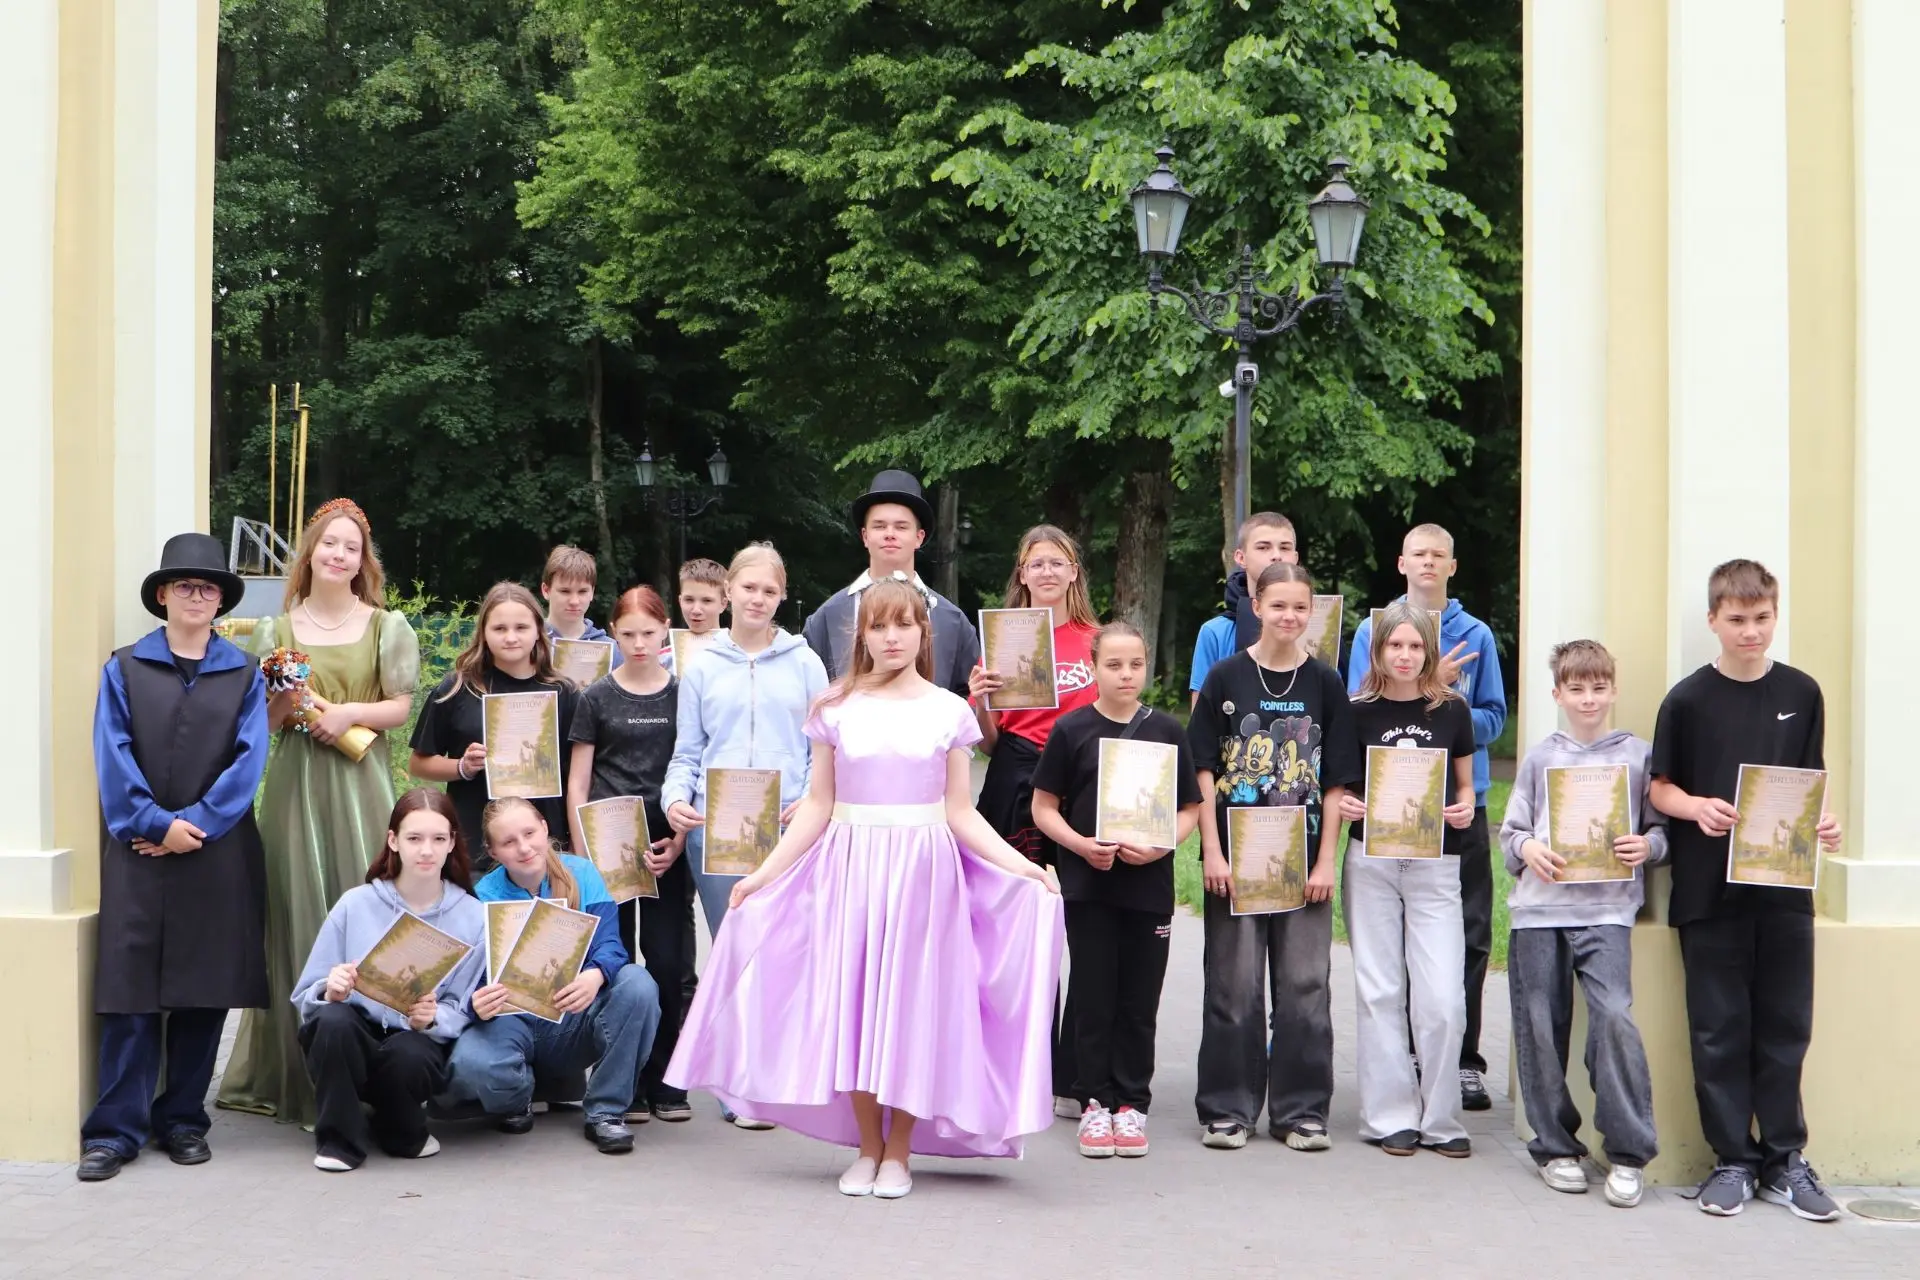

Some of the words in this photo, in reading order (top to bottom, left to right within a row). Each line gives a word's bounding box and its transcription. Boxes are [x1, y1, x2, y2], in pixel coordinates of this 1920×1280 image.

[1259, 699, 1305, 712] POINTLESS
[627, 717, 669, 725] BACKWARDES
[1381, 727, 1404, 743] This
[1405, 724, 1433, 742] Girl's
[1392, 755, 1430, 765] ДИПЛОМ
[729, 774, 766, 784] ДИПЛОМ
[1572, 773, 1612, 784] ДИПЛОМ
[1766, 774, 1810, 786] ДИПЛОМ
[1252, 815, 1290, 824] ДИПЛОМ
